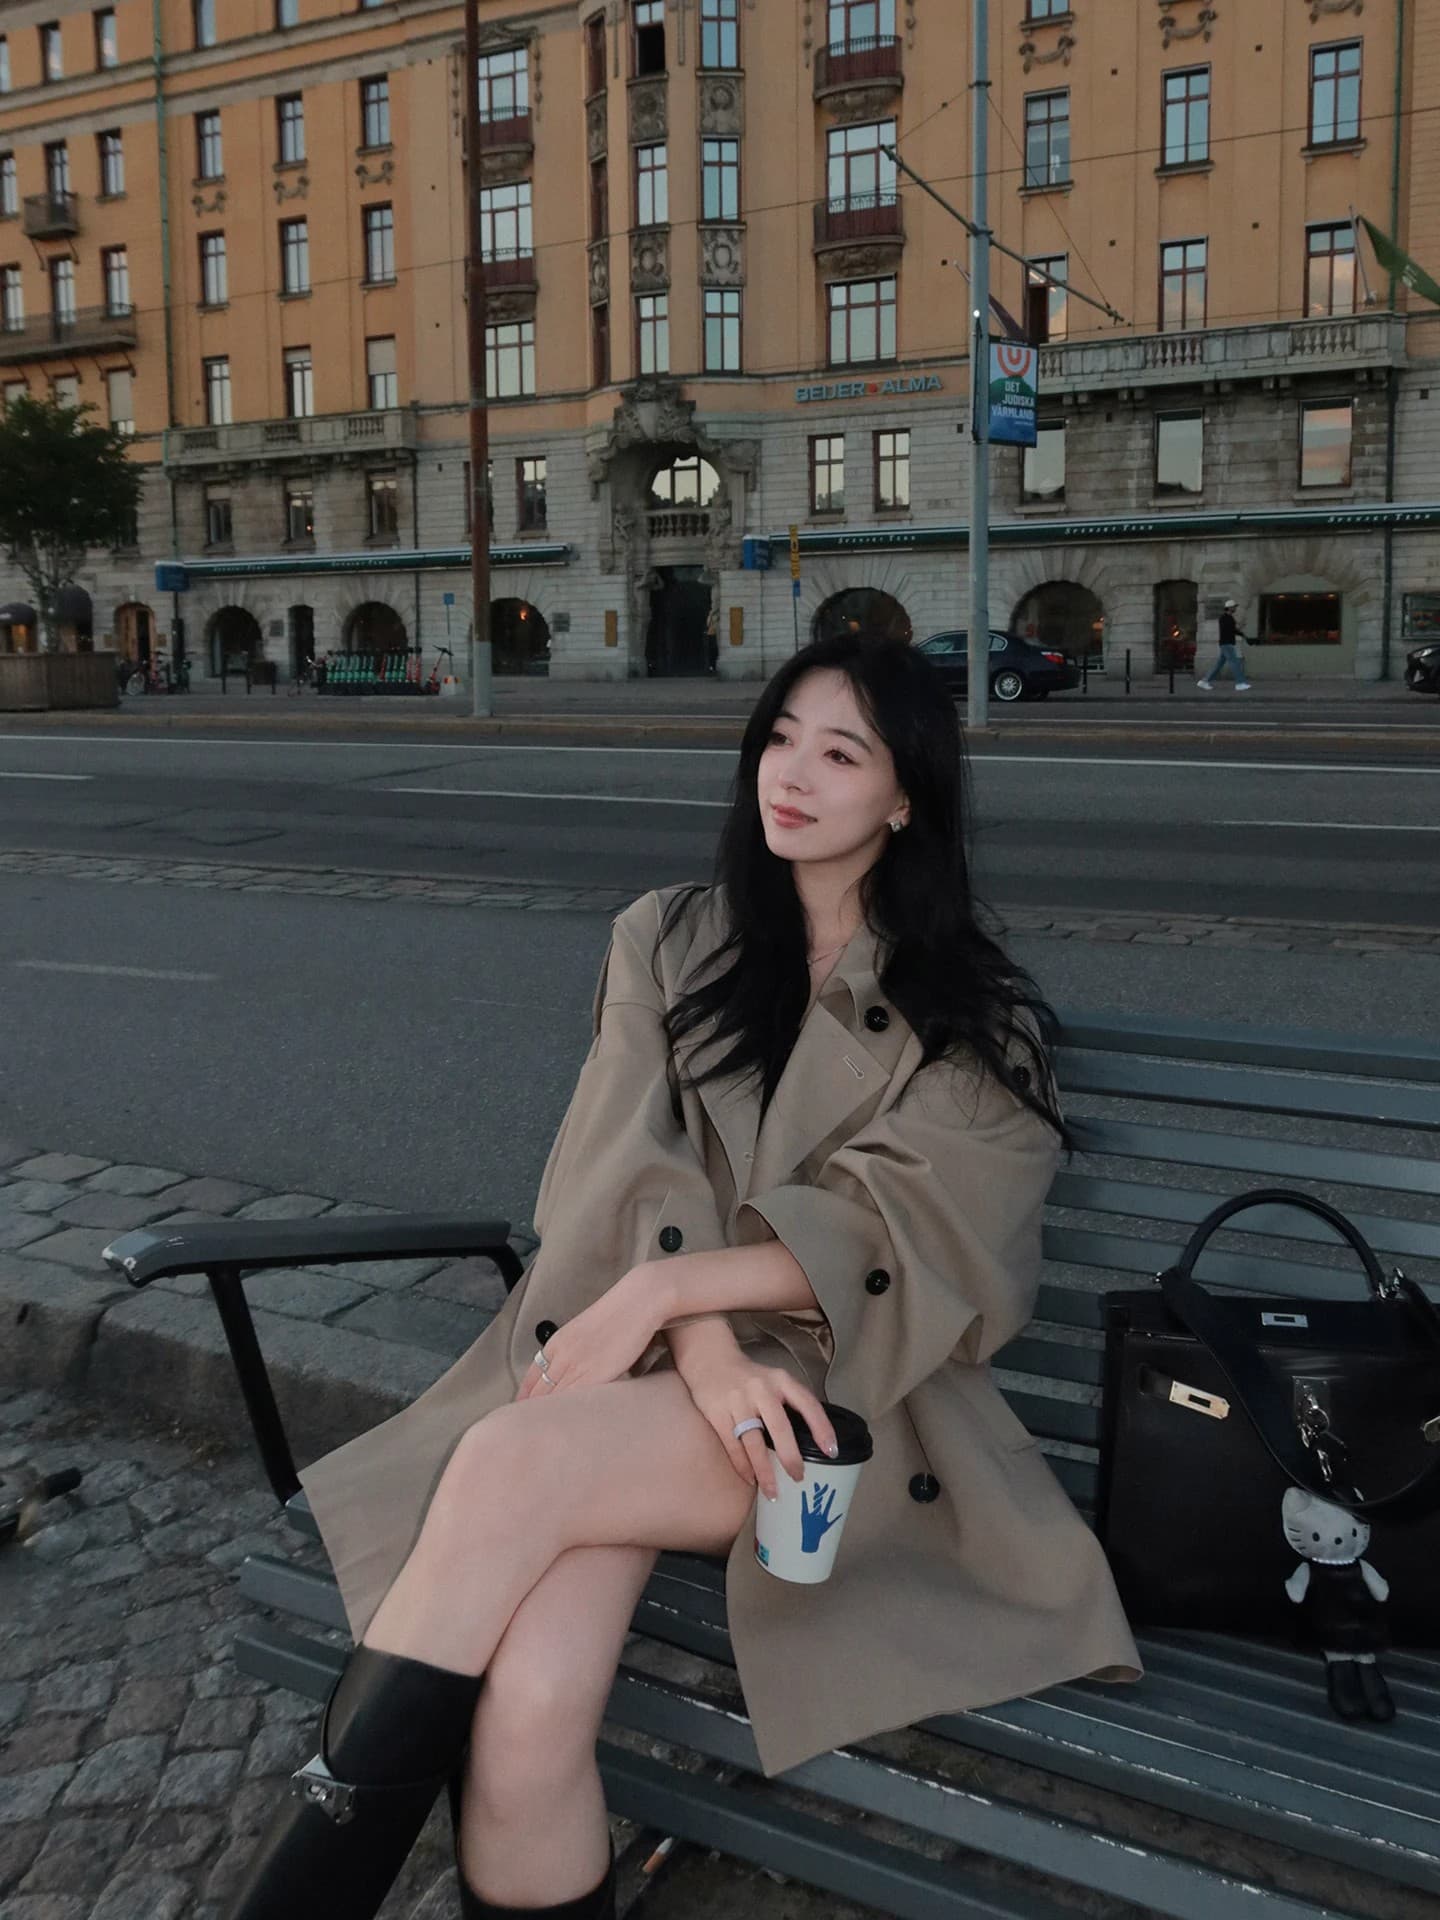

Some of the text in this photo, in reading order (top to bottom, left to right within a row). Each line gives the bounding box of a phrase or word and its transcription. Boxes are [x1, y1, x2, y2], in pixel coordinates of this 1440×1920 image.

[795, 375, 943, 402] BEIJER ALMA
[1004, 380, 1020, 393] DET
